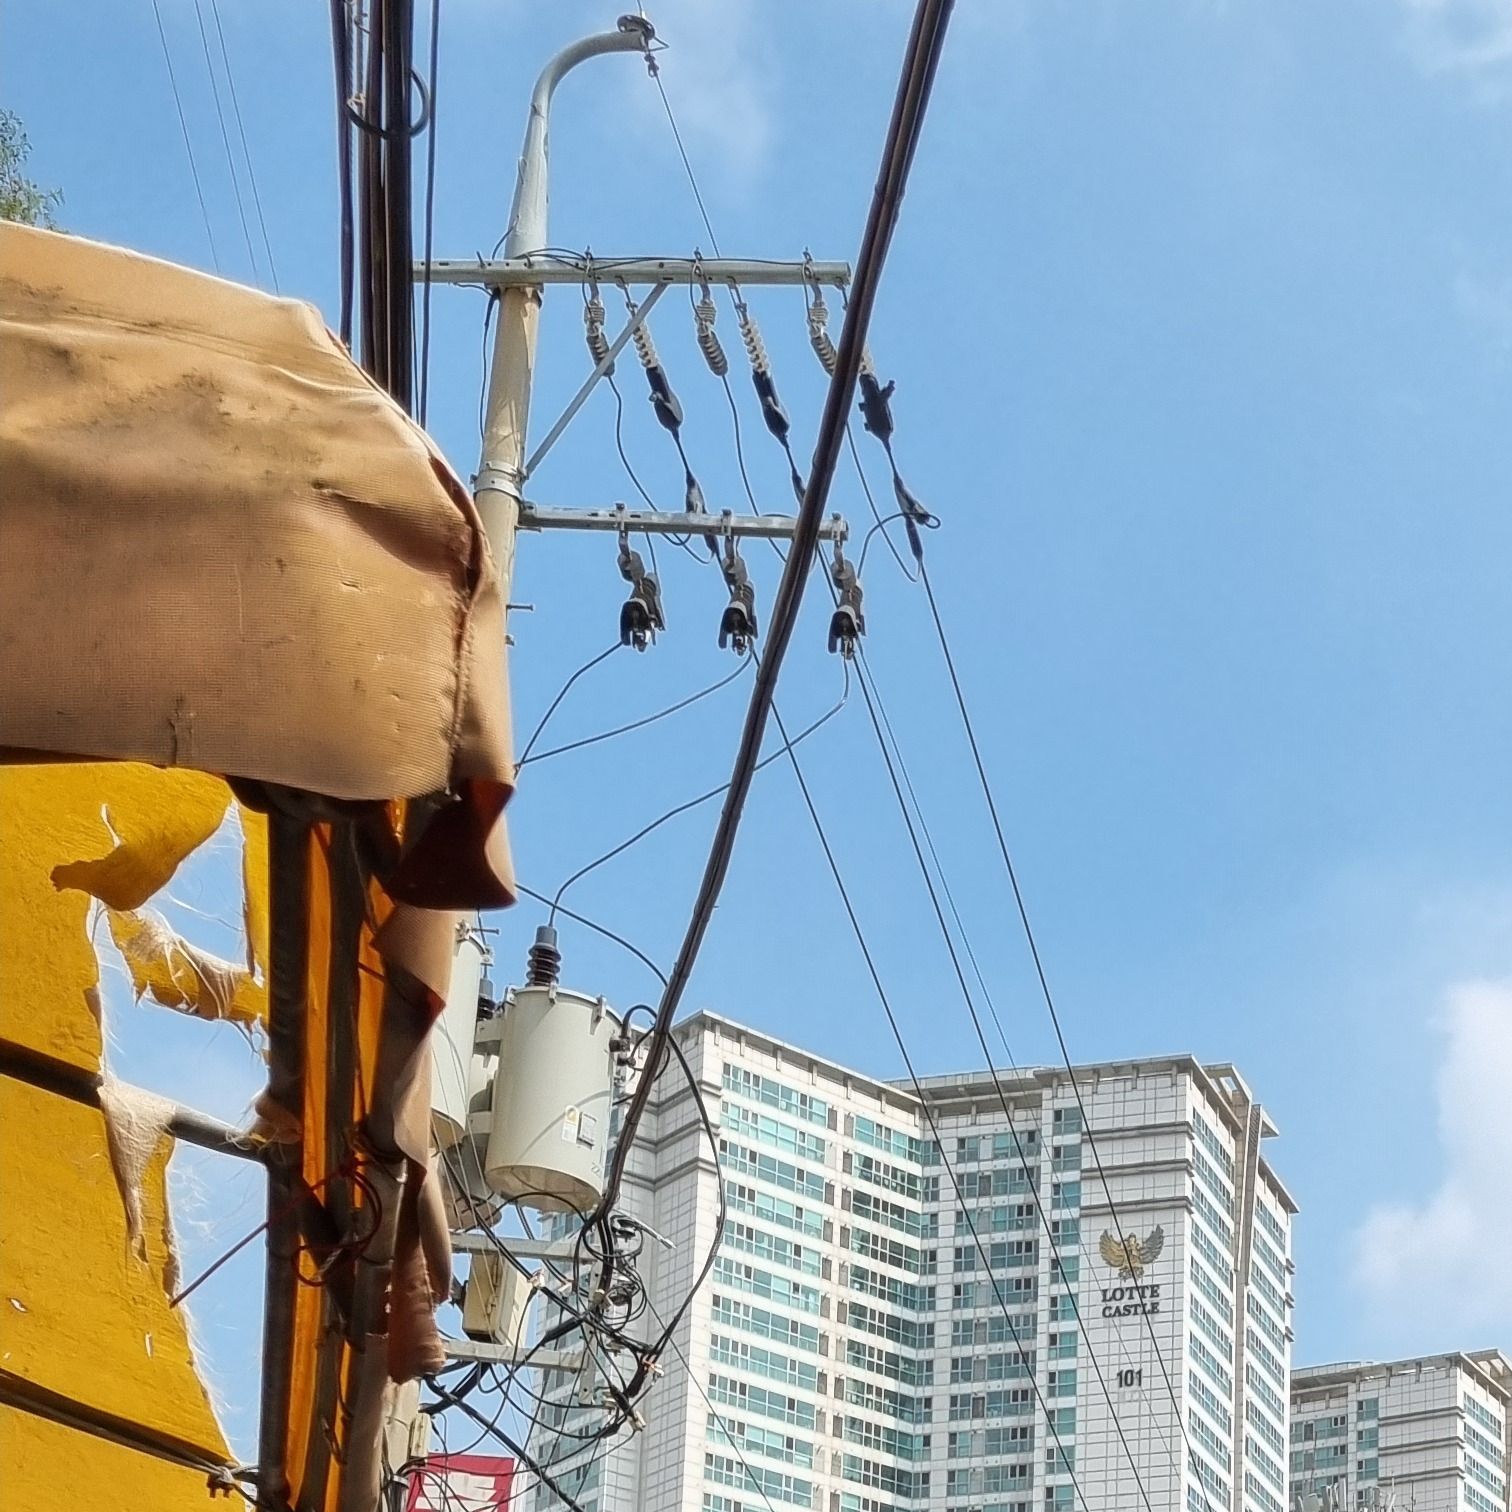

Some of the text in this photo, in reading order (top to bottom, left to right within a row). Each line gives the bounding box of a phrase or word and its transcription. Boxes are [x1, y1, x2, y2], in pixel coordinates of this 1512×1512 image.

[1101, 1284, 1160, 1302] LOTTE
[1102, 1302, 1160, 1318] CASTLE
[1117, 1369, 1142, 1388] 101
